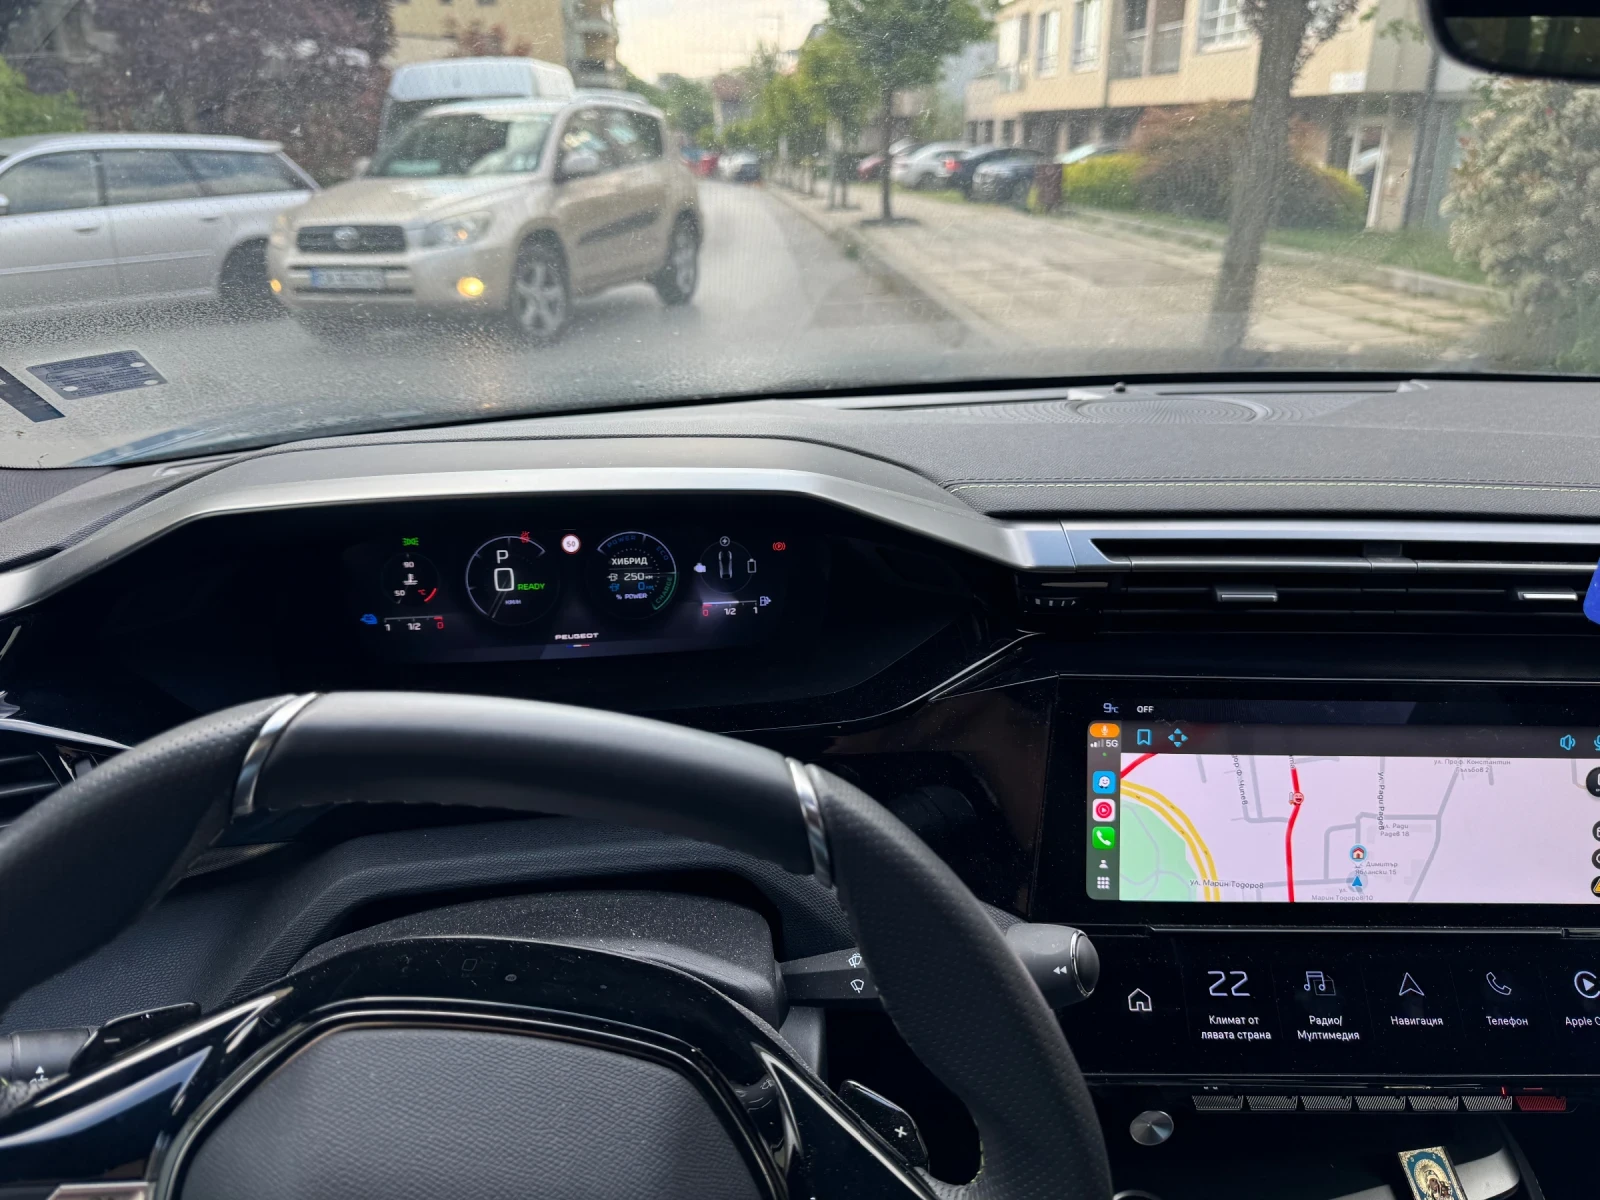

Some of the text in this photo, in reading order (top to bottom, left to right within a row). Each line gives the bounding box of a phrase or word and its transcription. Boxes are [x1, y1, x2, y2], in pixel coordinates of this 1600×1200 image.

[496, 549, 509, 564] P
[611, 557, 648, 566] ХИБРИД
[494, 567, 514, 591] 0
[517, 583, 545, 591] READY
[637, 581, 645, 591] 0
[384, 623, 391, 631] 1
[407, 622, 421, 630] 1/2
[555, 632, 599, 640] PEUGEOT
[1203, 880, 1229, 888] Марин
[1232, 881, 1264, 889] Тодоров
[1207, 970, 1251, 996] 22
[1209, 1015, 1260, 1025] Климат от
[1309, 1015, 1343, 1026] Радио/
[1390, 1016, 1444, 1027] Навигация
[1485, 1016, 1529, 1028] Телефон
[1565, 1016, 1592, 1028] Apple
[1201, 1031, 1272, 1041] лявата страна
[1297, 1030, 1360, 1042] Мултимедия
